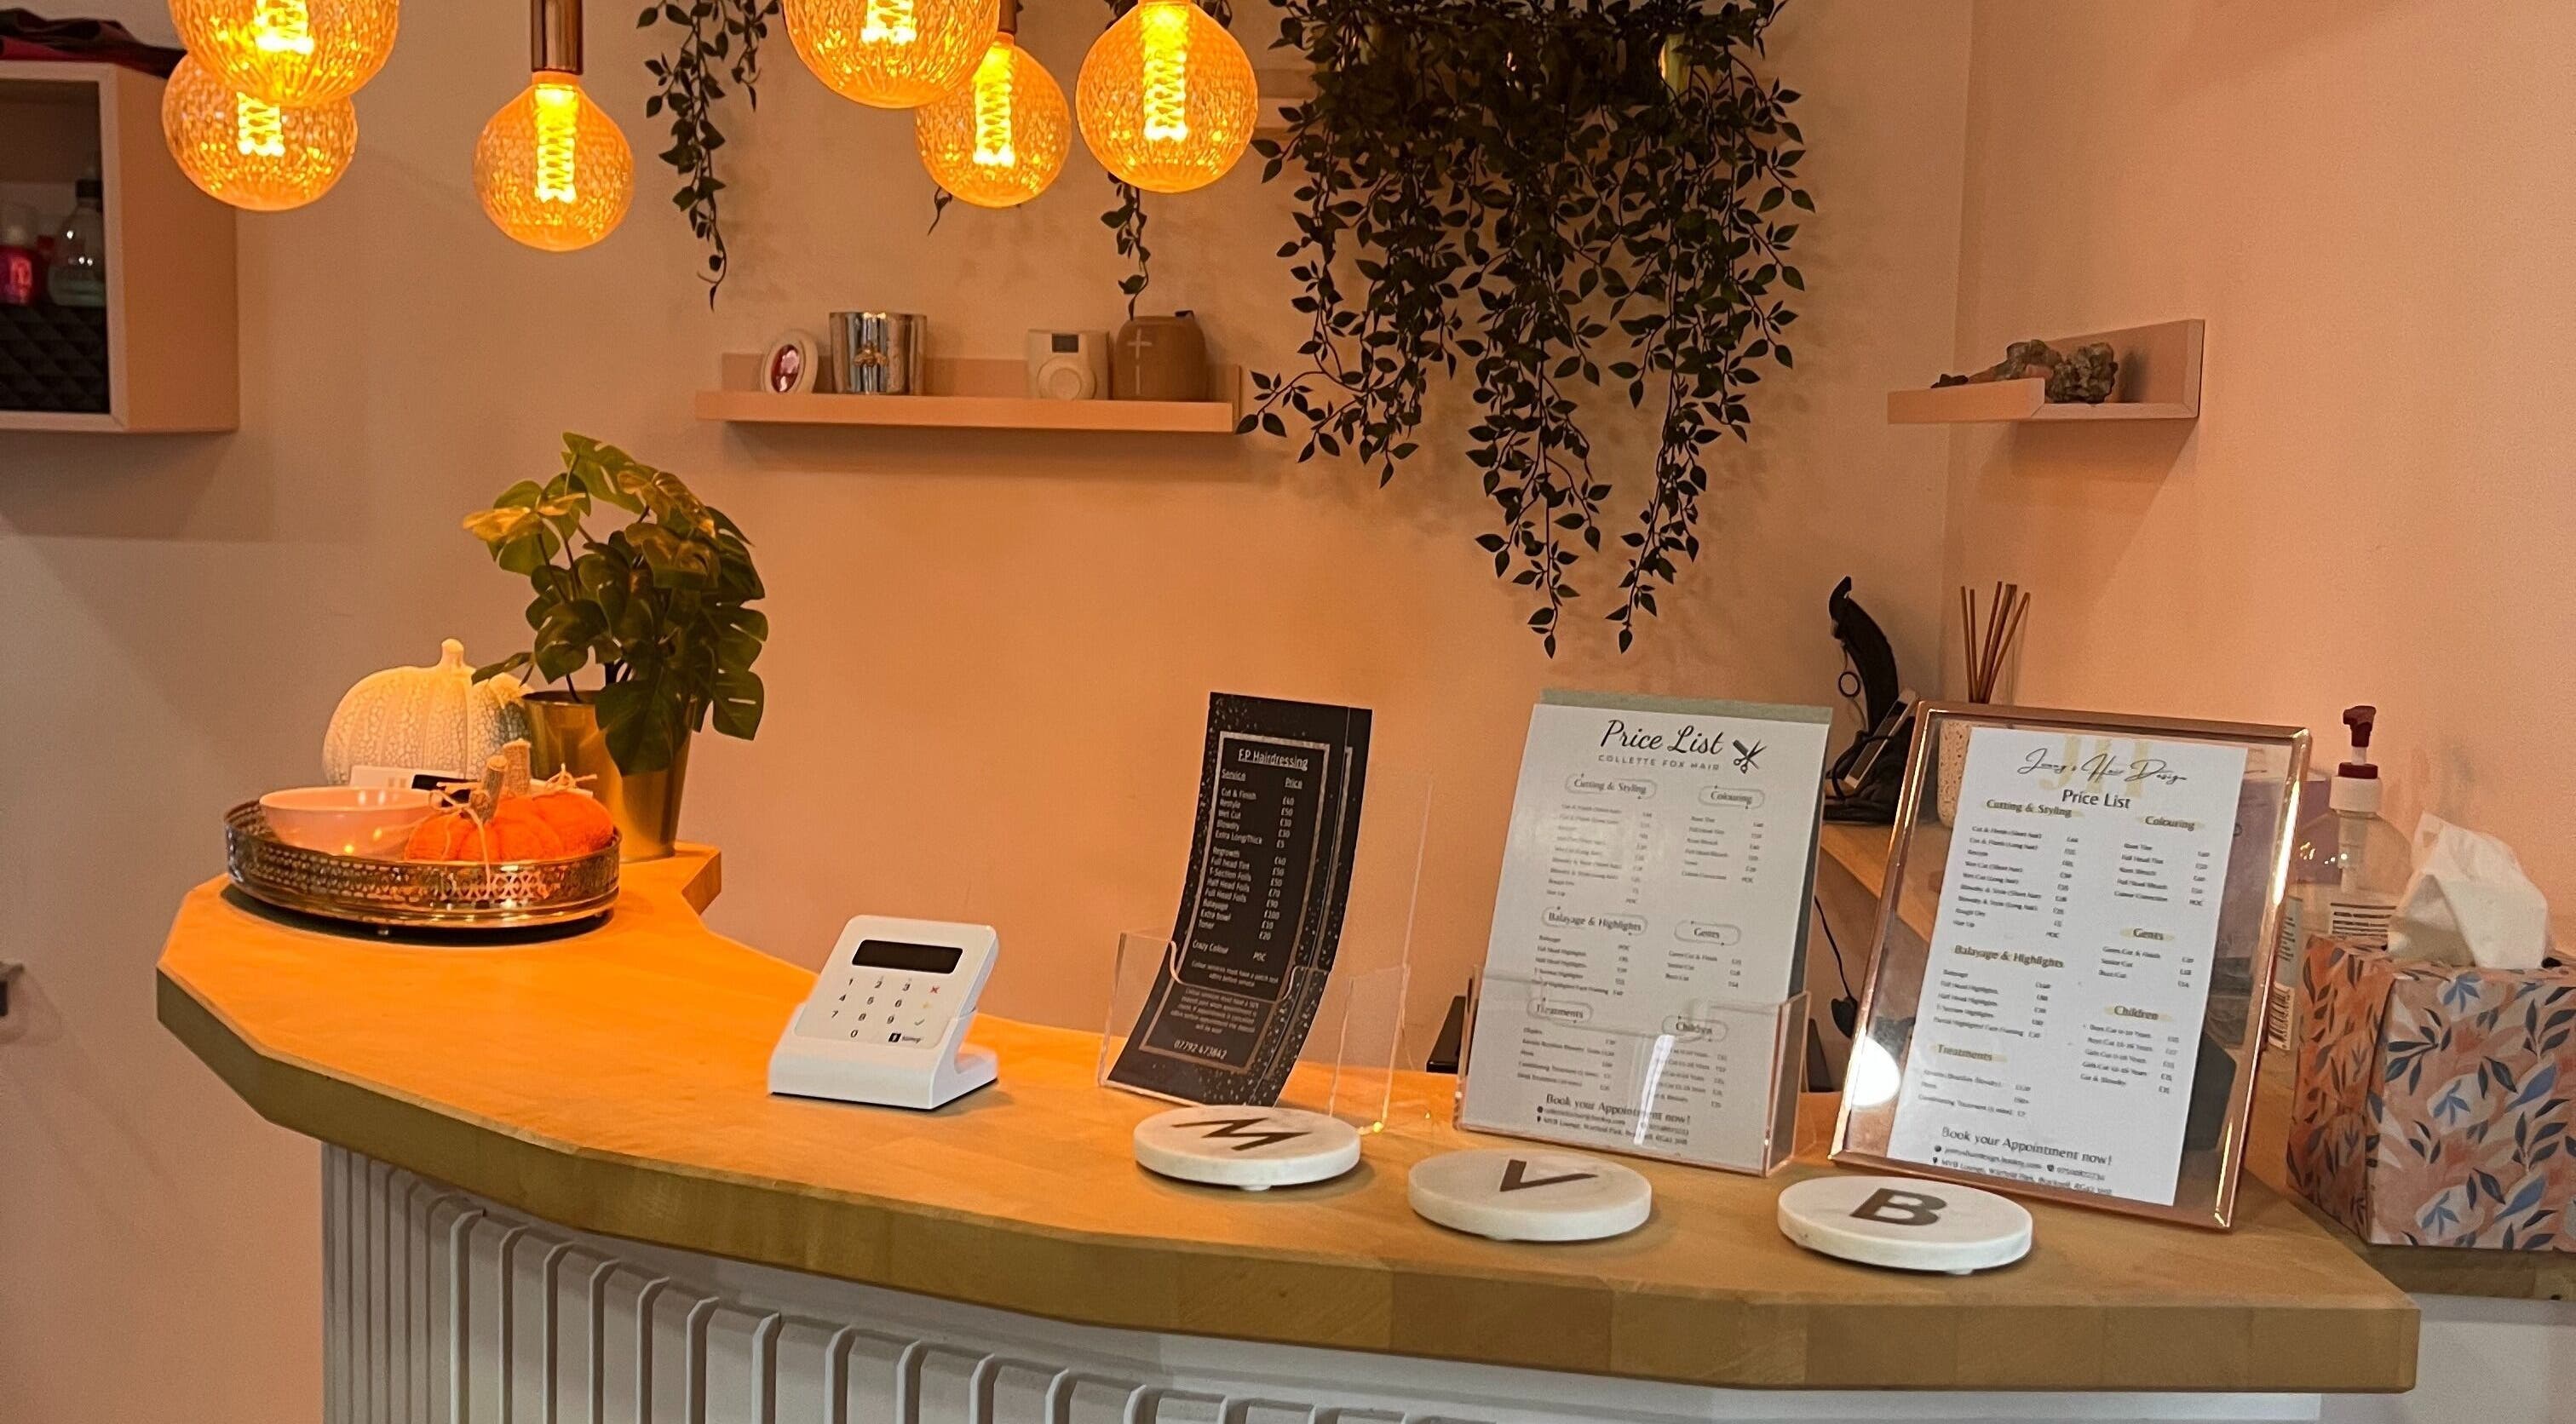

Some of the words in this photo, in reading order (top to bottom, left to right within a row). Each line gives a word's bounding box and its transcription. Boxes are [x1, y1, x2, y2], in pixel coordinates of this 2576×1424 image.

[1600, 719, 1663, 750] Price
[1666, 725, 1724, 755] List
[1253, 750, 1308, 771] Hairdressing
[1598, 755, 1656, 767] COLLETTE
[1662, 759, 1685, 768] FOX
[1690, 762, 1720, 771] HAIR
[2081, 753, 2125, 784] Hair
[2124, 759, 2188, 784] Design
[1221, 768, 1246, 781] Service
[1285, 777, 1302, 790] Price
[1573, 778, 1604, 791] Cutting
[1607, 781, 1615, 790] &
[1618, 783, 1647, 795] Styling
[1711, 790, 1752, 805] Colouring
[2061, 789, 2099, 806] Price
[2104, 794, 2131, 808] List
[1280, 807, 1293, 817] £50
[1987, 799, 2022, 812] Cutting
[2025, 803, 2034, 812] &
[2038, 804, 2073, 818] Styling
[2145, 815, 2195, 831] Colouring
[1549, 911, 1585, 926] Balayage
[1587, 916, 1596, 926] &
[1598, 917, 1642, 932] Highlights
[2133, 927, 2164, 941] Gents
[1954, 945, 1999, 961] Balayage
[2000, 950, 2010, 961] &
[2013, 952, 2065, 968] Highlights
[1536, 1003, 1584, 1019] Treatments
[2114, 1005, 2159, 1020] Children
[1938, 1044, 1993, 1061] Treatments
[1546, 1093, 1571, 1106] Book
[1574, 1100, 1596, 1111] your
[1665, 1113, 1691, 1126] now!
[1170, 1117, 1313, 1151] M
[1942, 1126, 1971, 1141] Book
[1975, 1134, 2000, 1146] your
[2002, 1137, 2079, 1161] Appointment
[2082, 1152, 2113, 1166] now!
[1499, 1159, 1599, 1191] V
[1849, 1188, 1947, 1226] B
